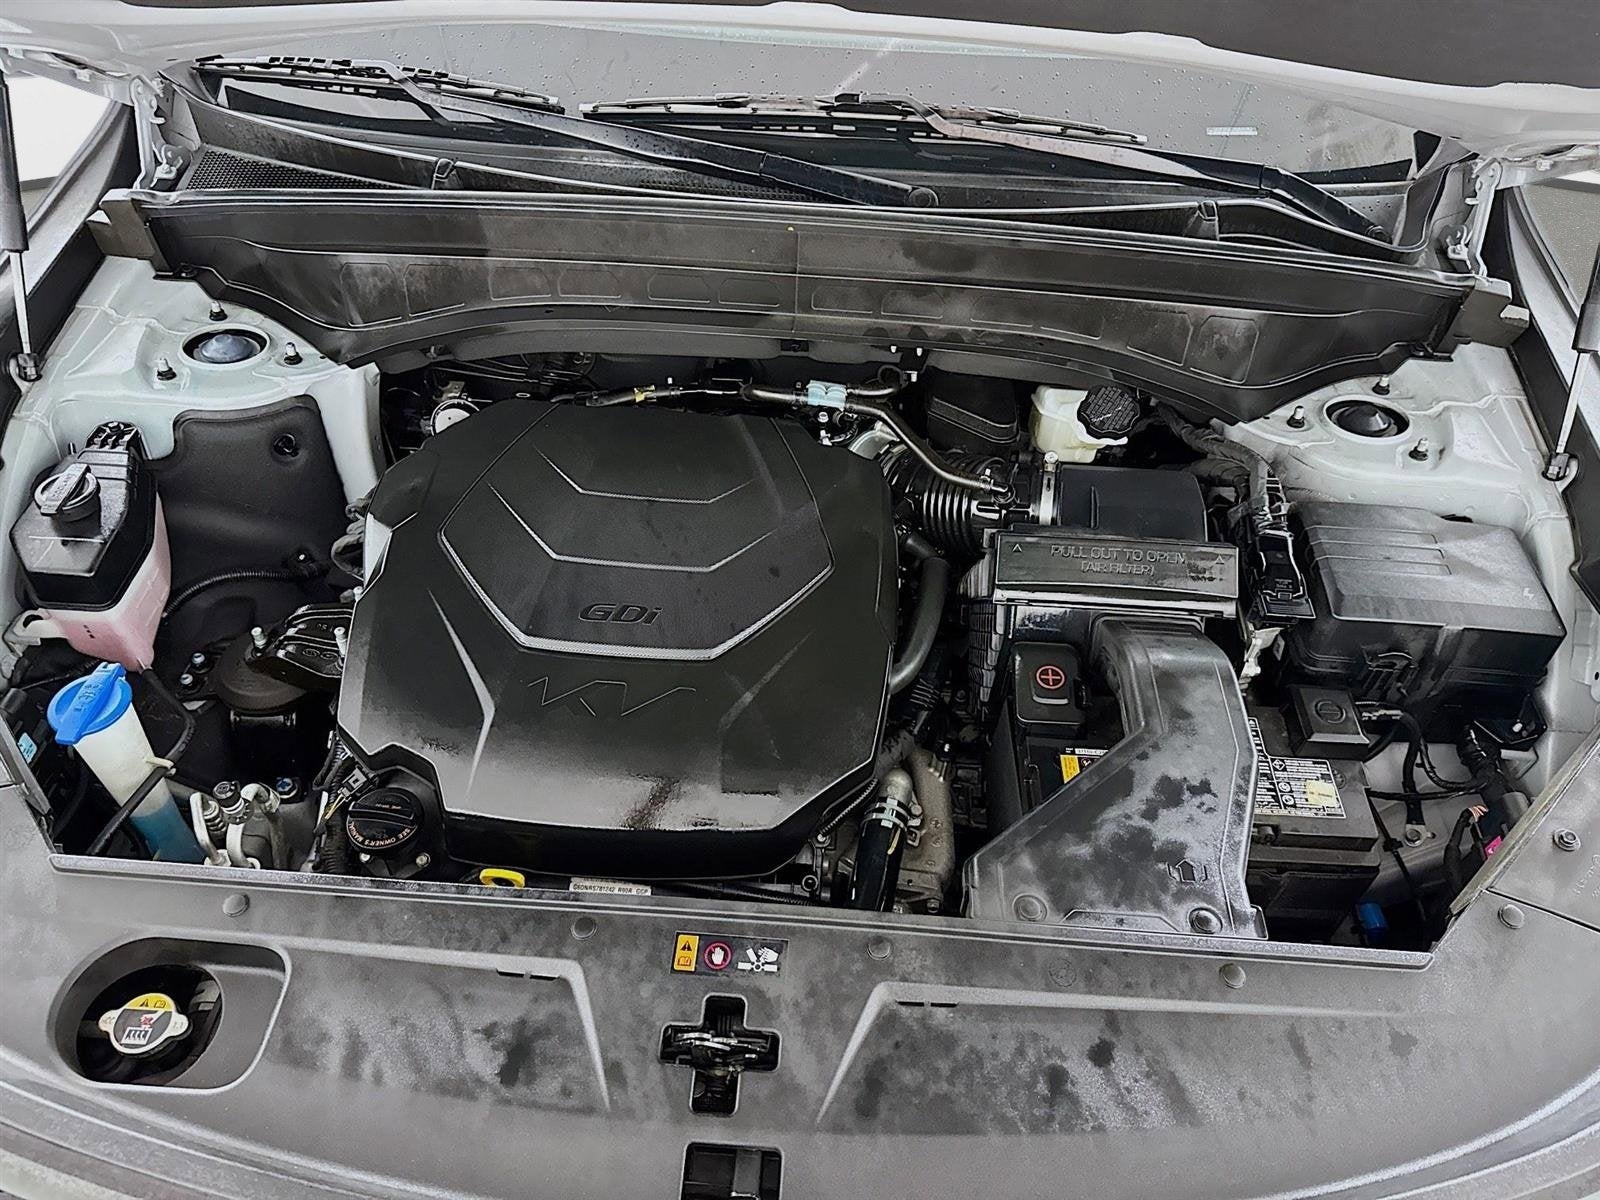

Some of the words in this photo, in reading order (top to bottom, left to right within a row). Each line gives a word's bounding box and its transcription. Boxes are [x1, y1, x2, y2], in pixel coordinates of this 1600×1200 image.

[1050, 545, 1088, 559] PULL
[1090, 546, 1121, 560] OUT
[1123, 548, 1144, 561] TO
[1146, 550, 1187, 565] OPEN
[578, 603, 664, 626] GDi
[348, 821, 364, 842] MANUAL
[364, 837, 396, 846] OWNER'S
[398, 828, 411, 839] SEE
